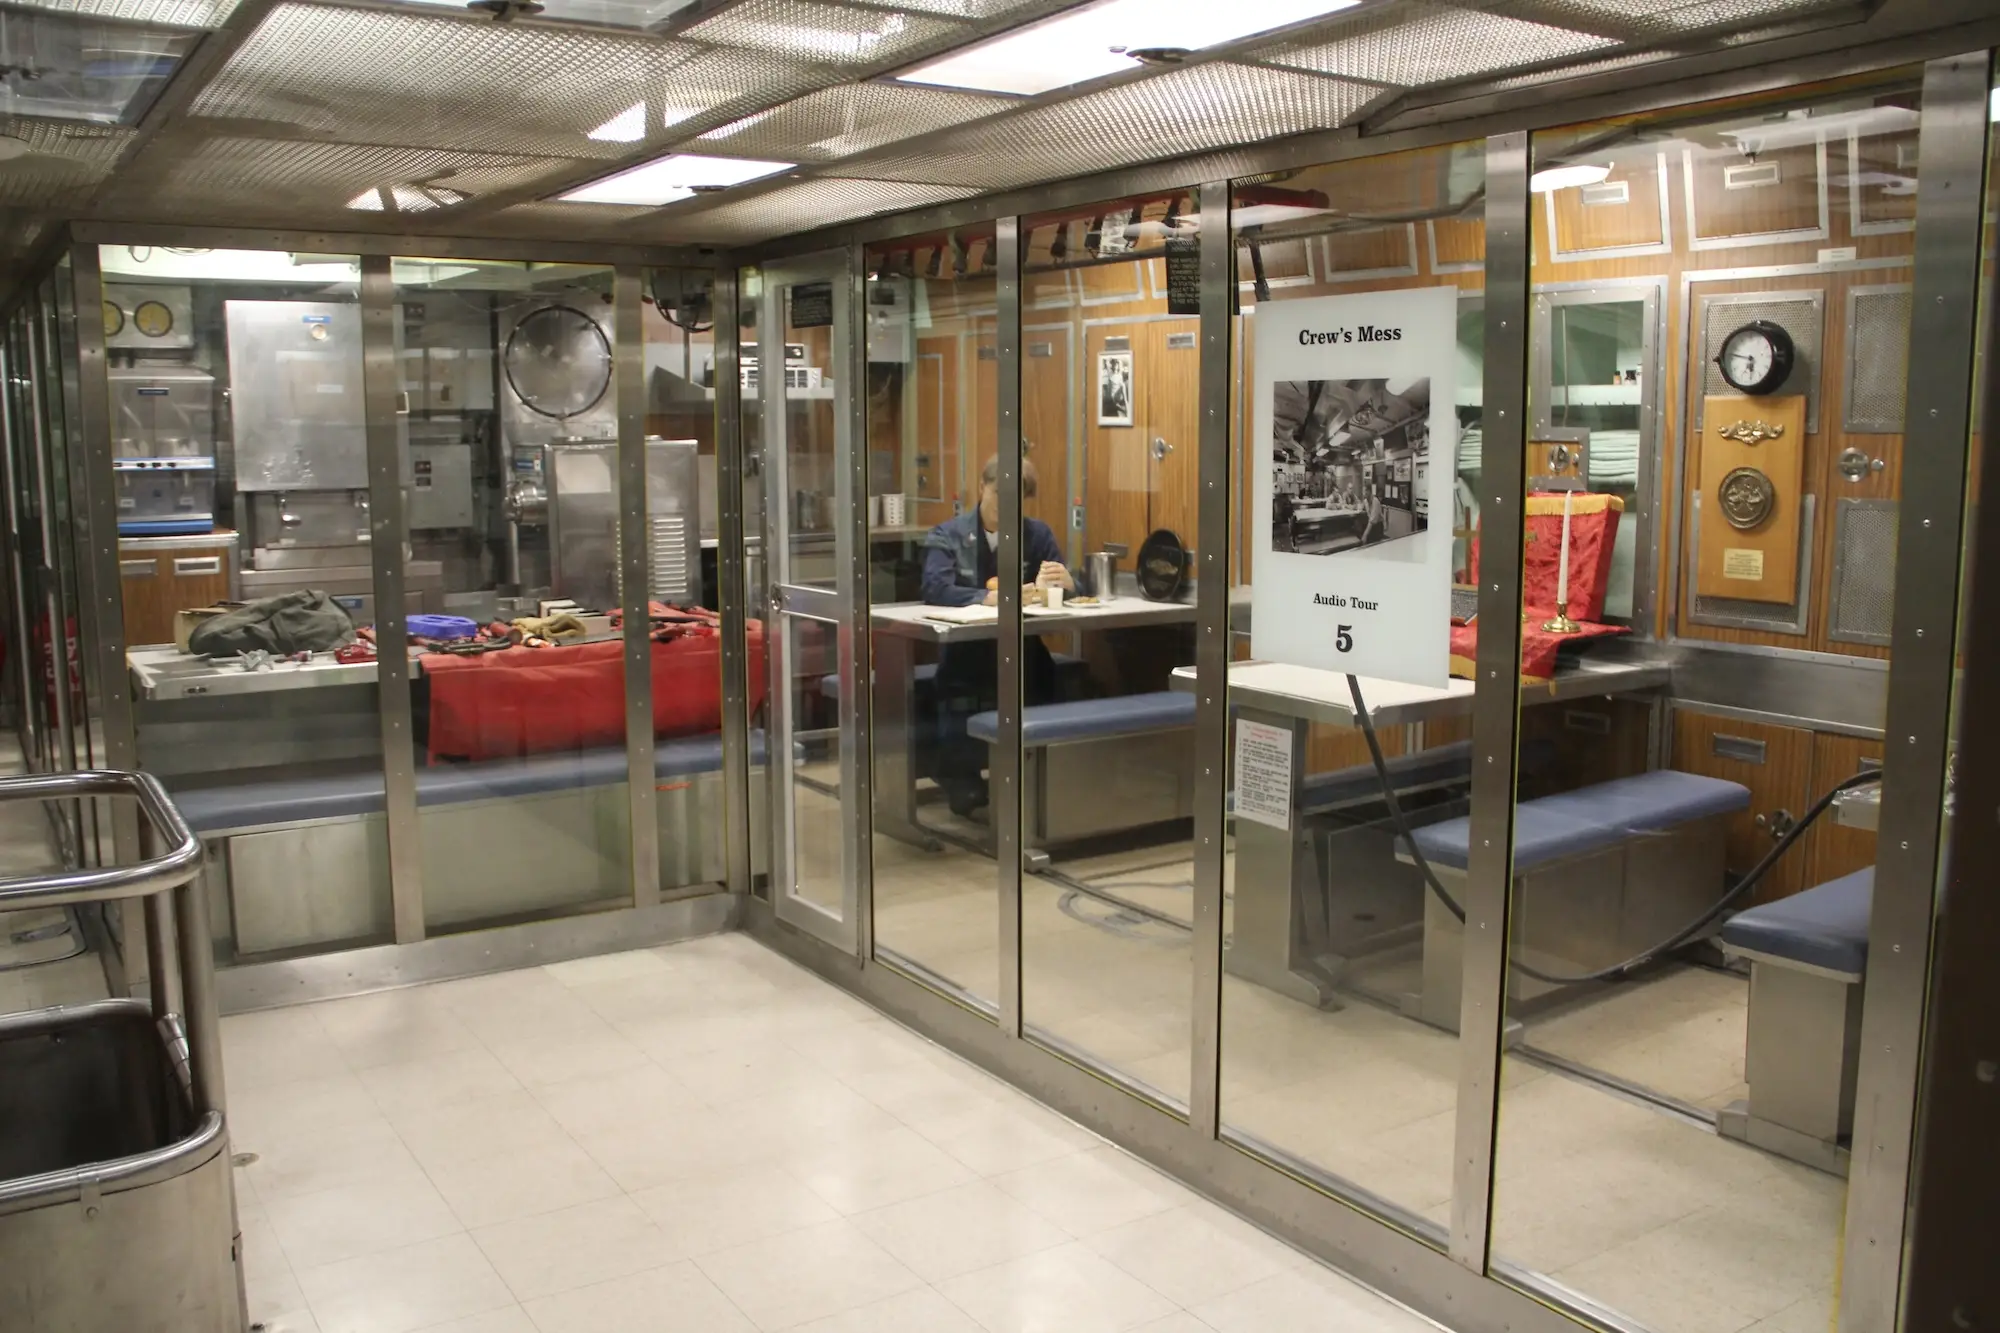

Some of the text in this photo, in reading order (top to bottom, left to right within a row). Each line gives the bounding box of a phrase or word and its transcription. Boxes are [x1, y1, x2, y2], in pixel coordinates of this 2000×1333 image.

[1298, 326, 1402, 346] Crew's Mess
[1313, 593, 1379, 611] Audio Tour
[1335, 625, 1353, 653] 5
